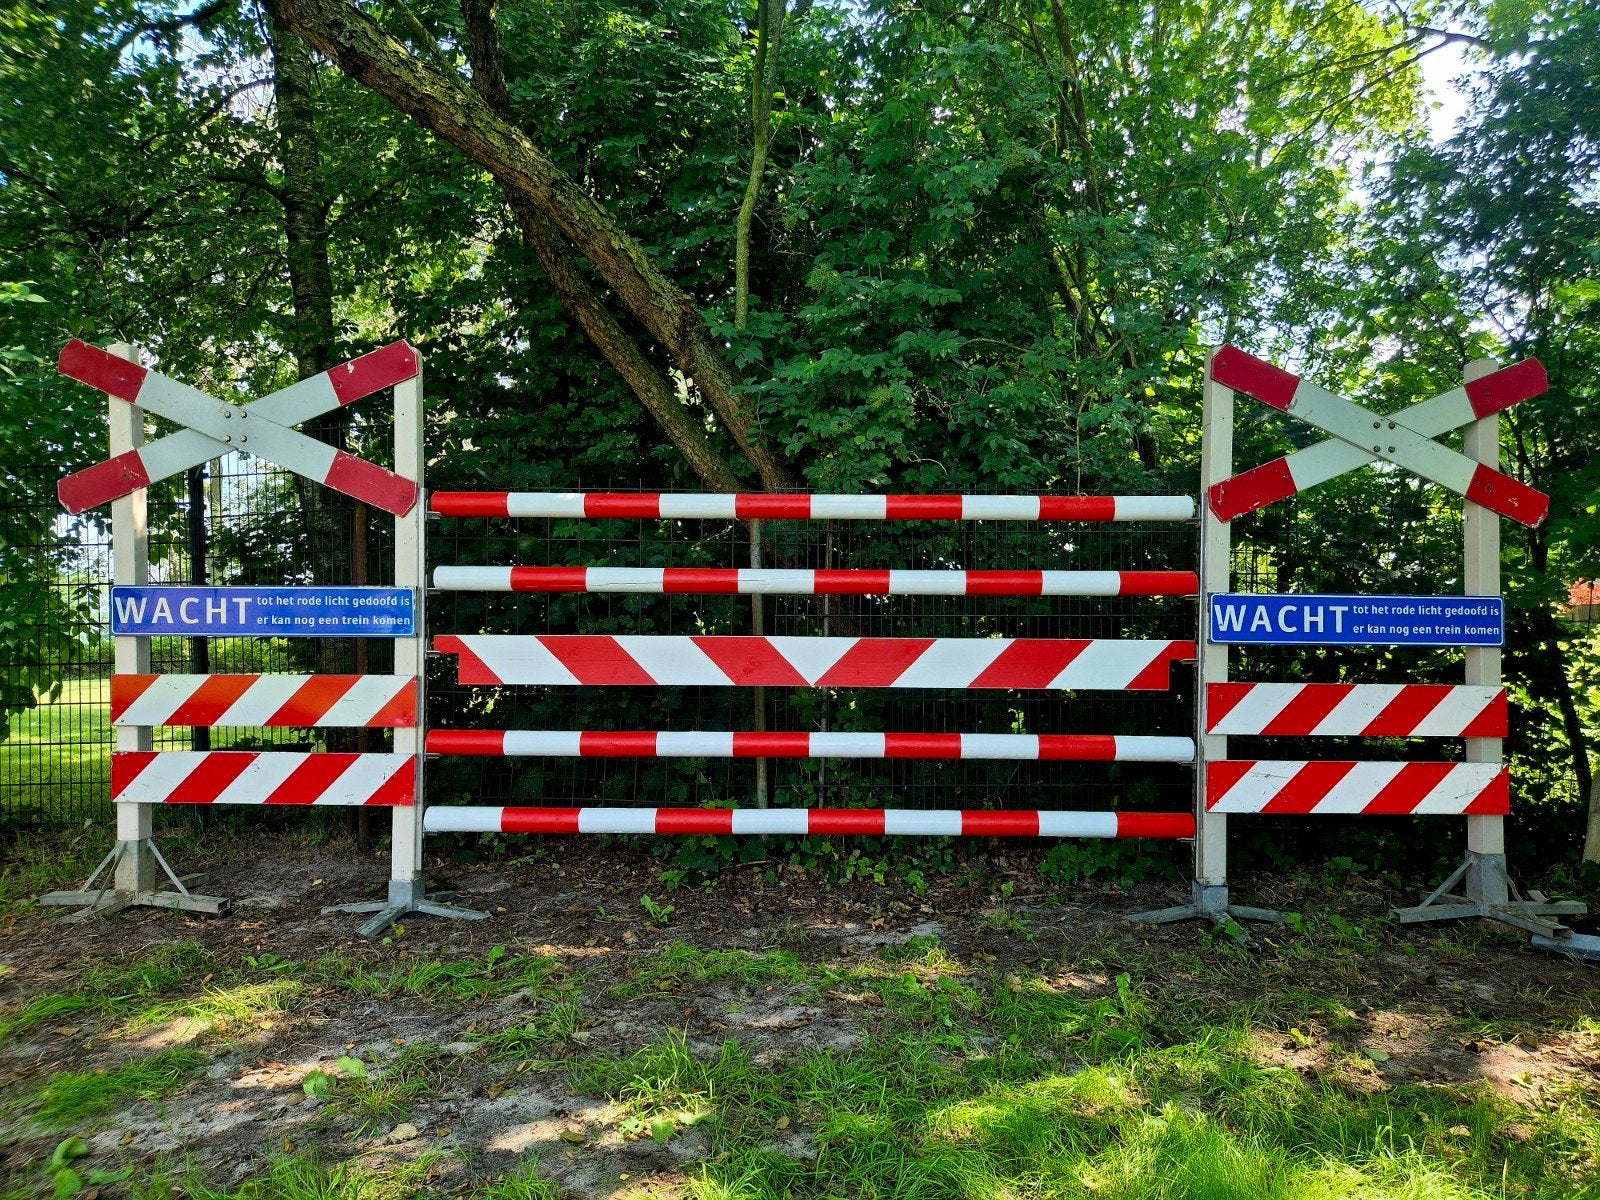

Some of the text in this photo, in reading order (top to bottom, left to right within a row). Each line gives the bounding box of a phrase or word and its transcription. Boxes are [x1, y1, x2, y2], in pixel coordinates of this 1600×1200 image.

[257, 595, 410, 608] tot het rode licht gedoofd is
[114, 597, 253, 625] WACHT
[1352, 605, 1500, 618] tot het rode licht gedoofd is
[257, 615, 411, 627] er kan nog een trein komen
[1213, 604, 1349, 633] WACHT
[1352, 624, 1500, 636] er kan nog een trein komen
